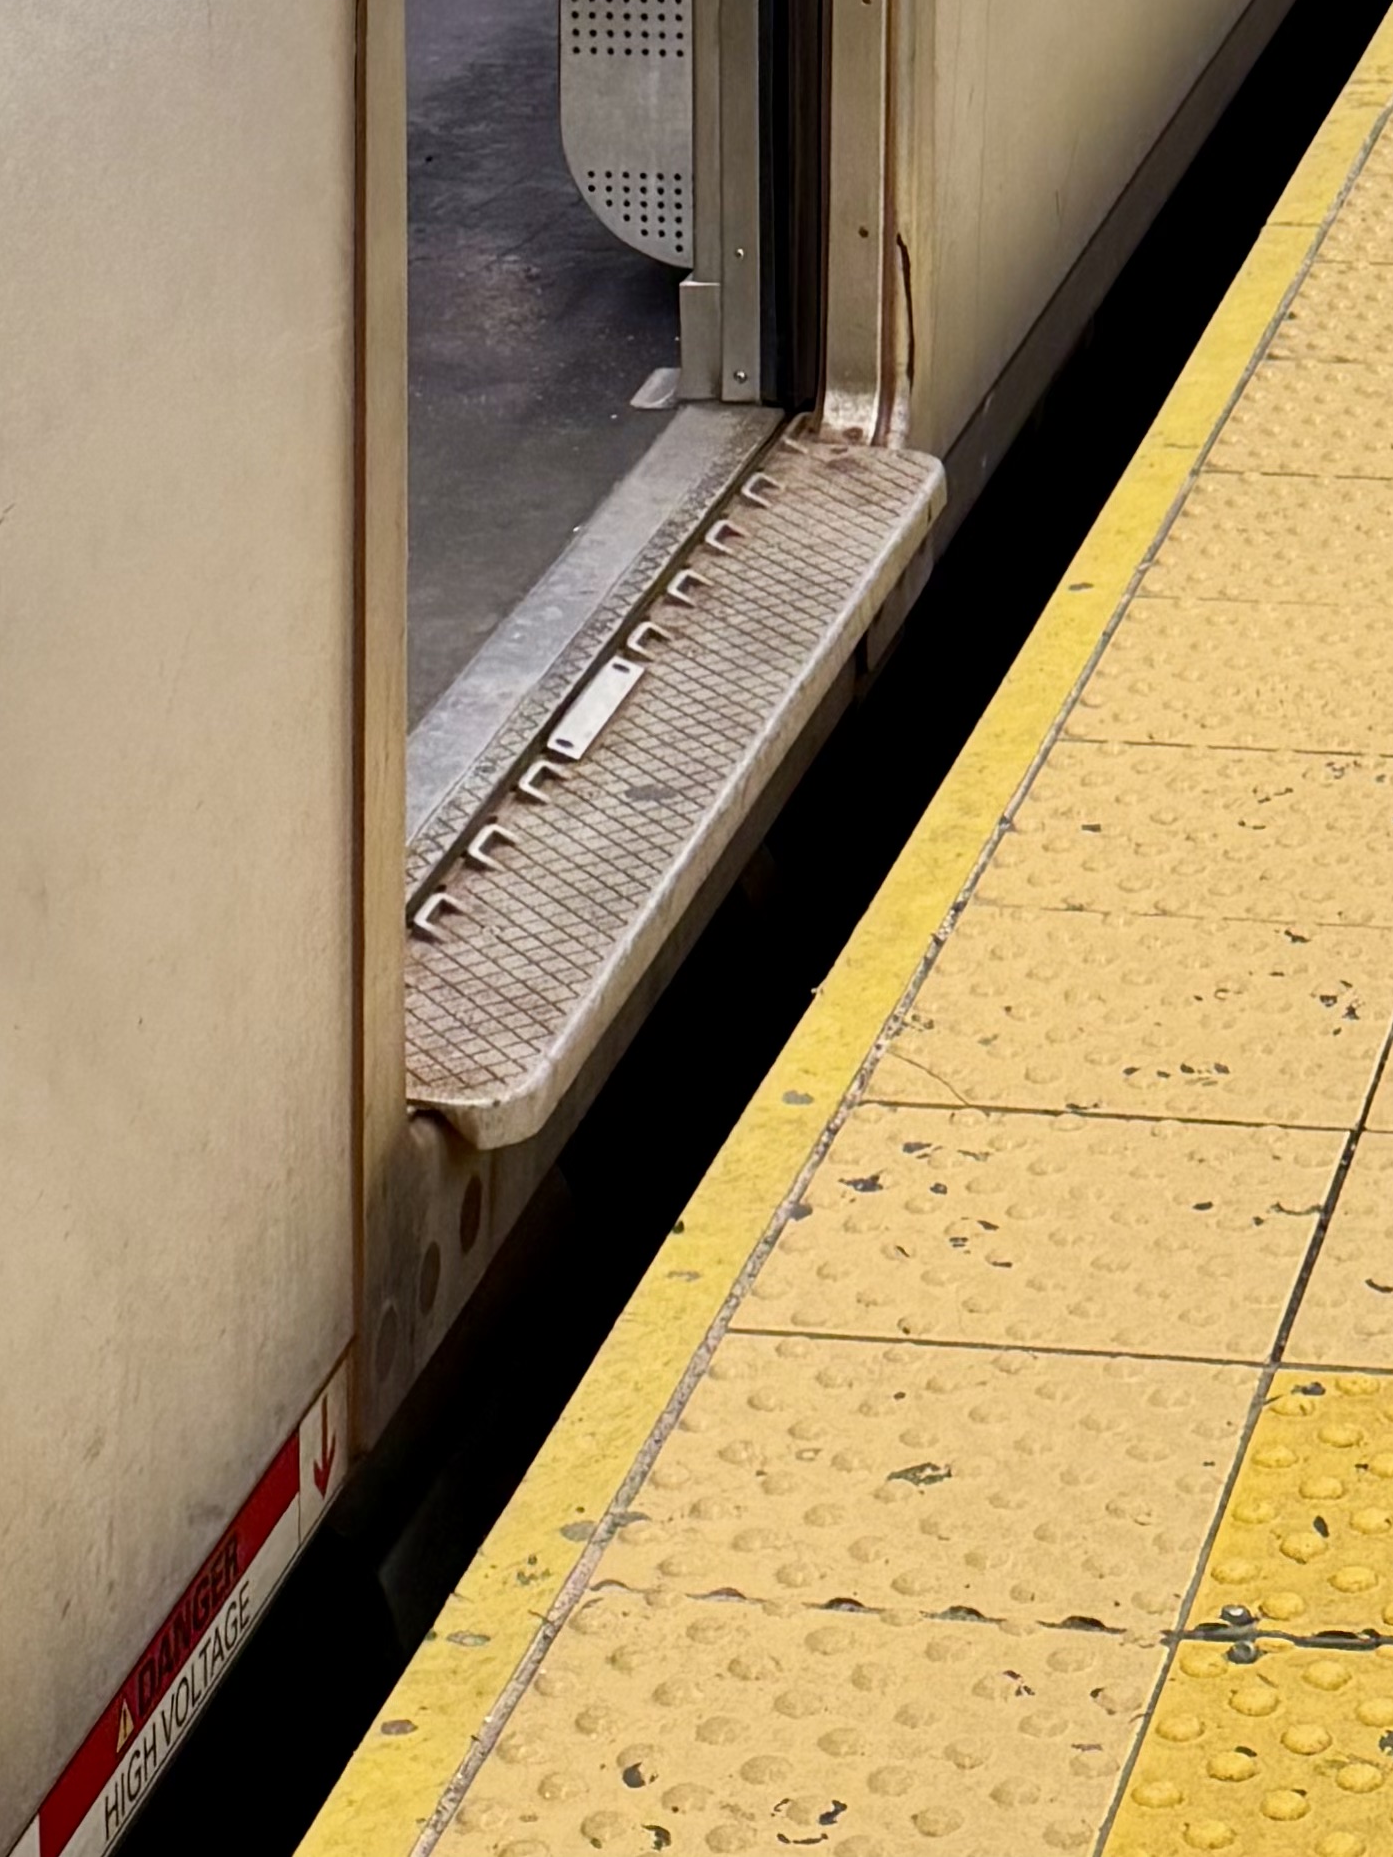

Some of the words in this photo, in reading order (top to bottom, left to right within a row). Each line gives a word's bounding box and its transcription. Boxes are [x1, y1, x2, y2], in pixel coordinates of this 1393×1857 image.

[104, 1721, 158, 1842] HIGH
[160, 1579, 250, 1748] VOLTAGE
[136, 1535, 239, 1719] DANGER
